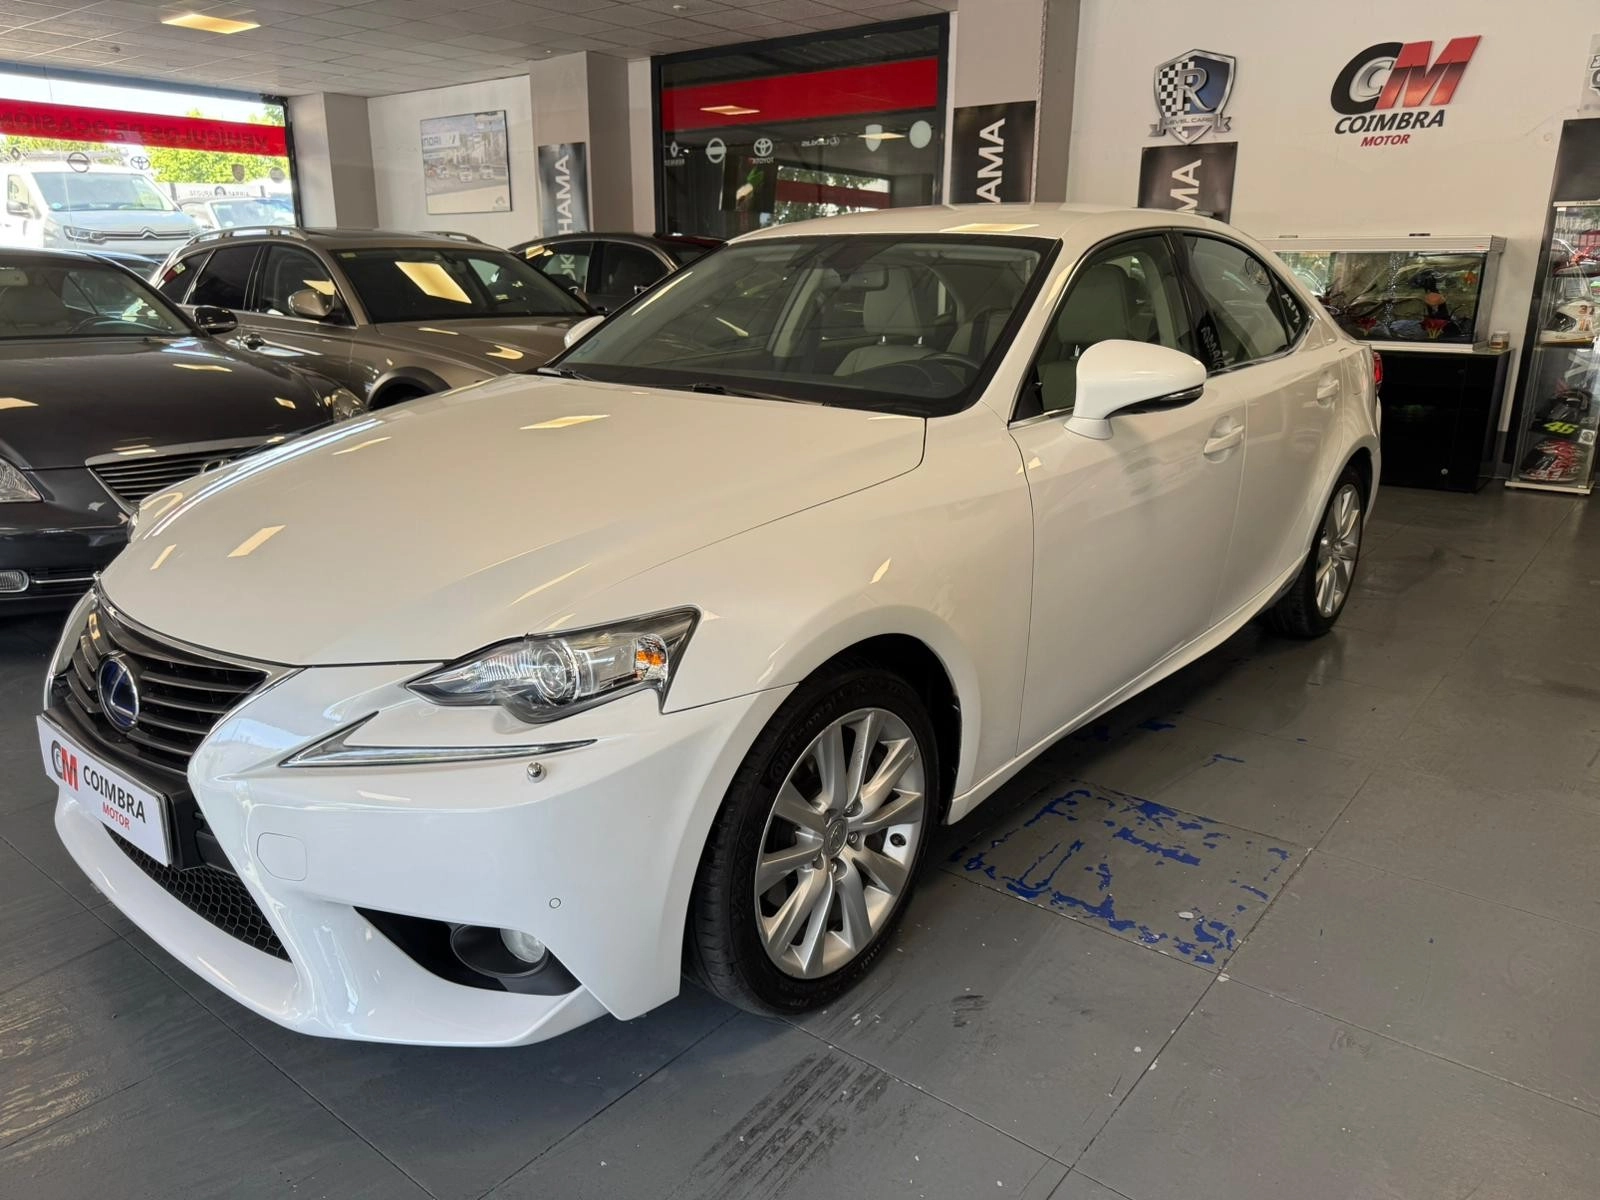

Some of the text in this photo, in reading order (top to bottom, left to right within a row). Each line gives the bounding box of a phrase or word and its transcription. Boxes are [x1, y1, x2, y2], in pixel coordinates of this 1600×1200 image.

[1177, 67, 1217, 112] R
[1335, 109, 1445, 135] COIMBRA
[1360, 134, 1410, 147] MOTOR
[83, 765, 146, 824] COIMBRA
[103, 802, 130, 831] MOTOR
